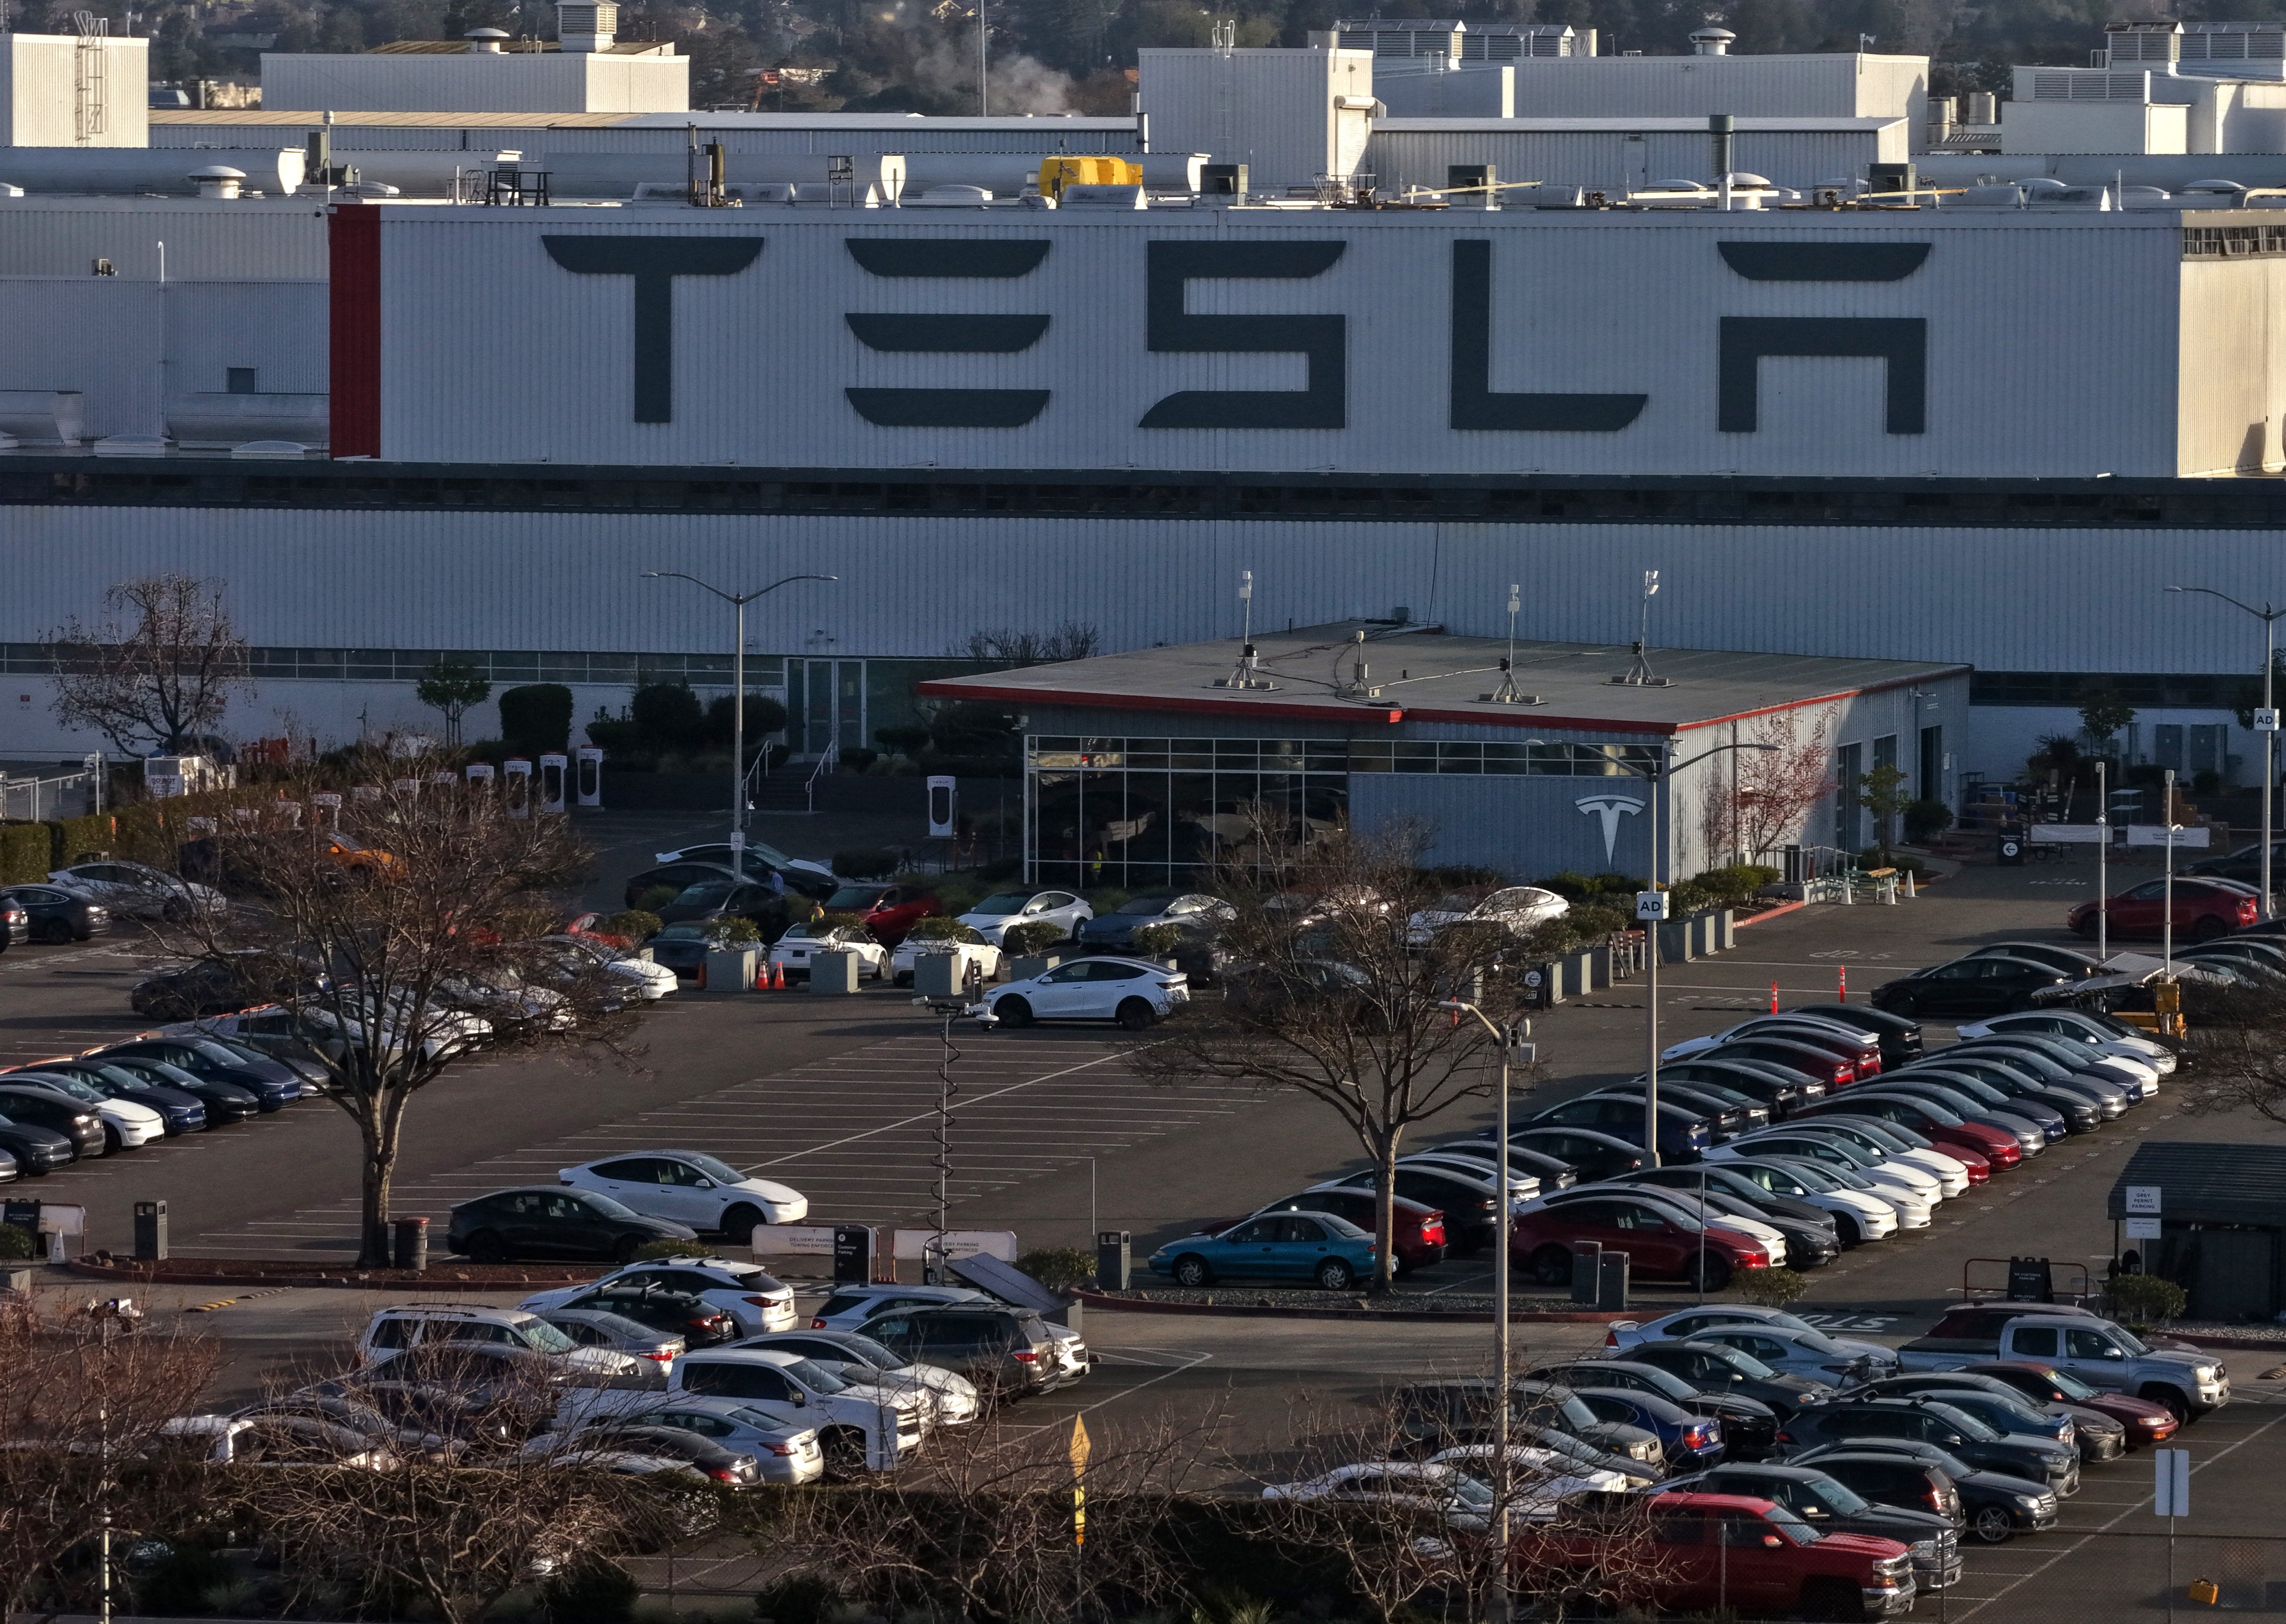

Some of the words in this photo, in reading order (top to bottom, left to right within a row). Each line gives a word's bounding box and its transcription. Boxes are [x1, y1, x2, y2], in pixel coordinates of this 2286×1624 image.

[541, 234, 1933, 436] TESLA
[2256, 716, 2273, 724] AD
[1640, 901, 1661, 911] AD
